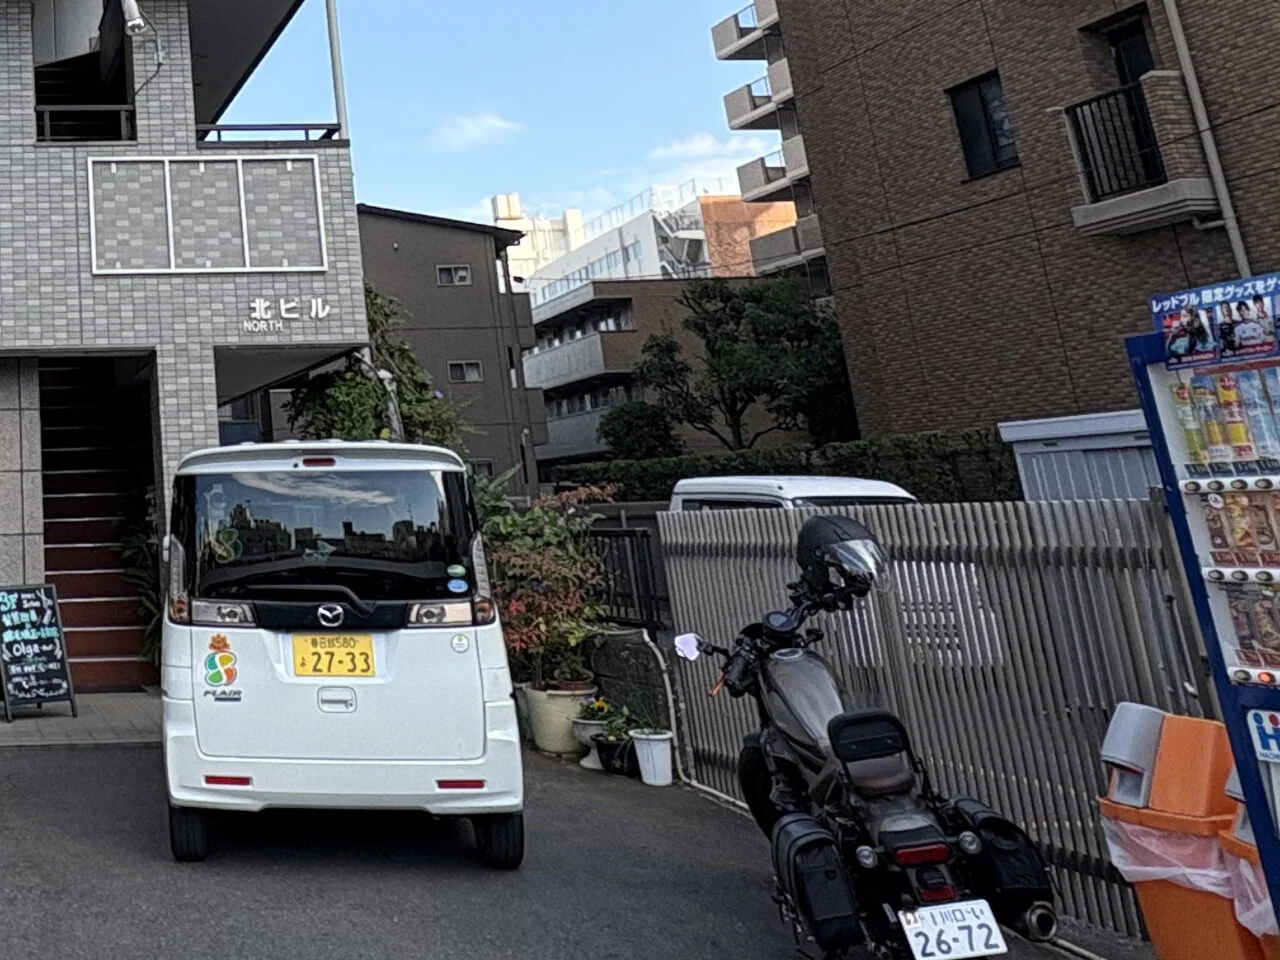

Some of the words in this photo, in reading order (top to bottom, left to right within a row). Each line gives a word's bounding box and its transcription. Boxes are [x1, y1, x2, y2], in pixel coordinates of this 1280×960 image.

[1201, 277, 1280, 307] 限定グッズをゲ
[250, 297, 331, 319] 北ビル
[243, 320, 283, 333] NORTH
[12, 642, 40, 658] Olga
[311, 651, 371, 673] 27-33
[914, 923, 1000, 958] 26-72
